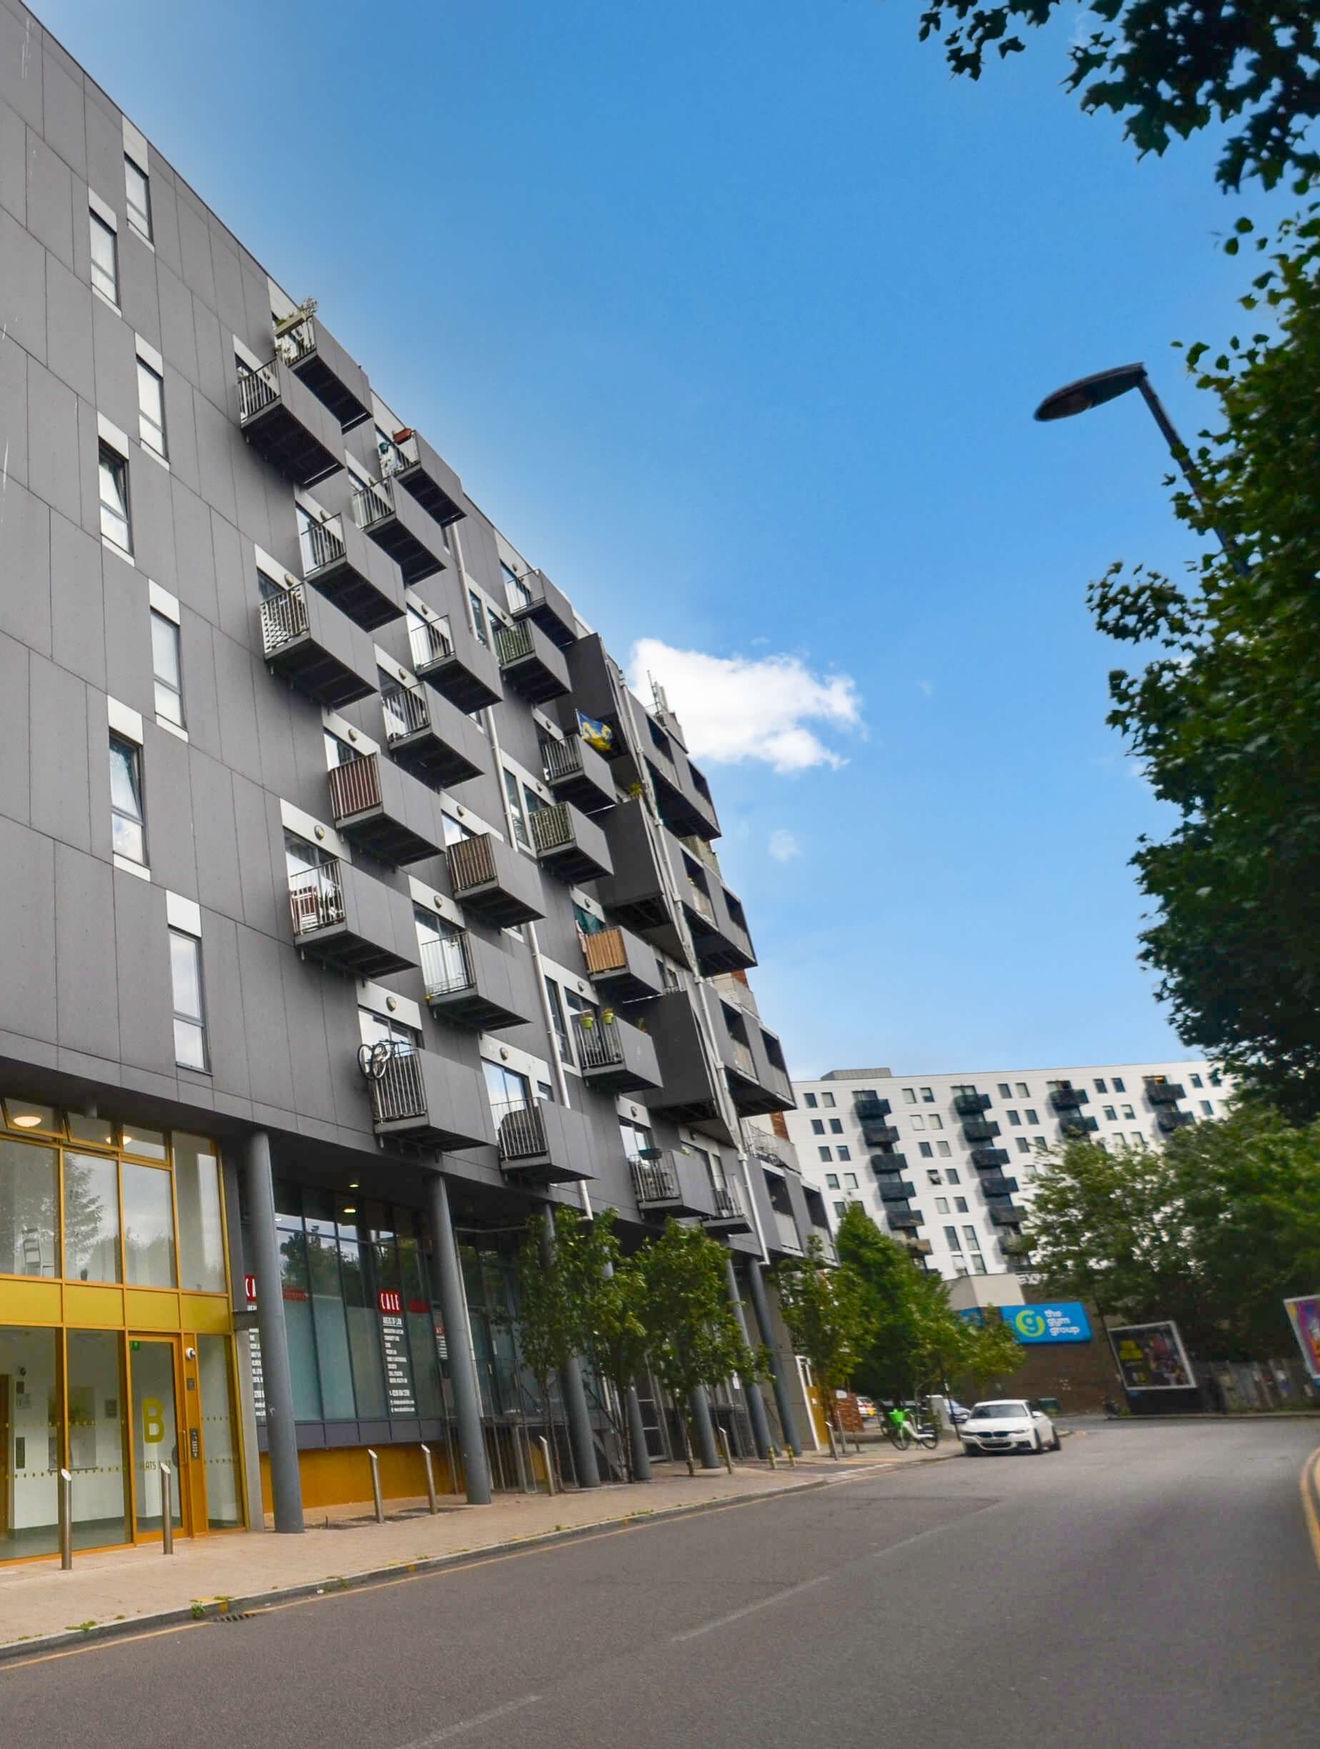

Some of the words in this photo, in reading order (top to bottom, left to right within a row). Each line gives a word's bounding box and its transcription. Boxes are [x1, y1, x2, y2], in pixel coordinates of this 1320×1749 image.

[1043, 1309, 1062, 1318] the
[1046, 1317, 1071, 1327] gym
[1049, 1326, 1080, 1336] group
[143, 1398, 165, 1443] B
